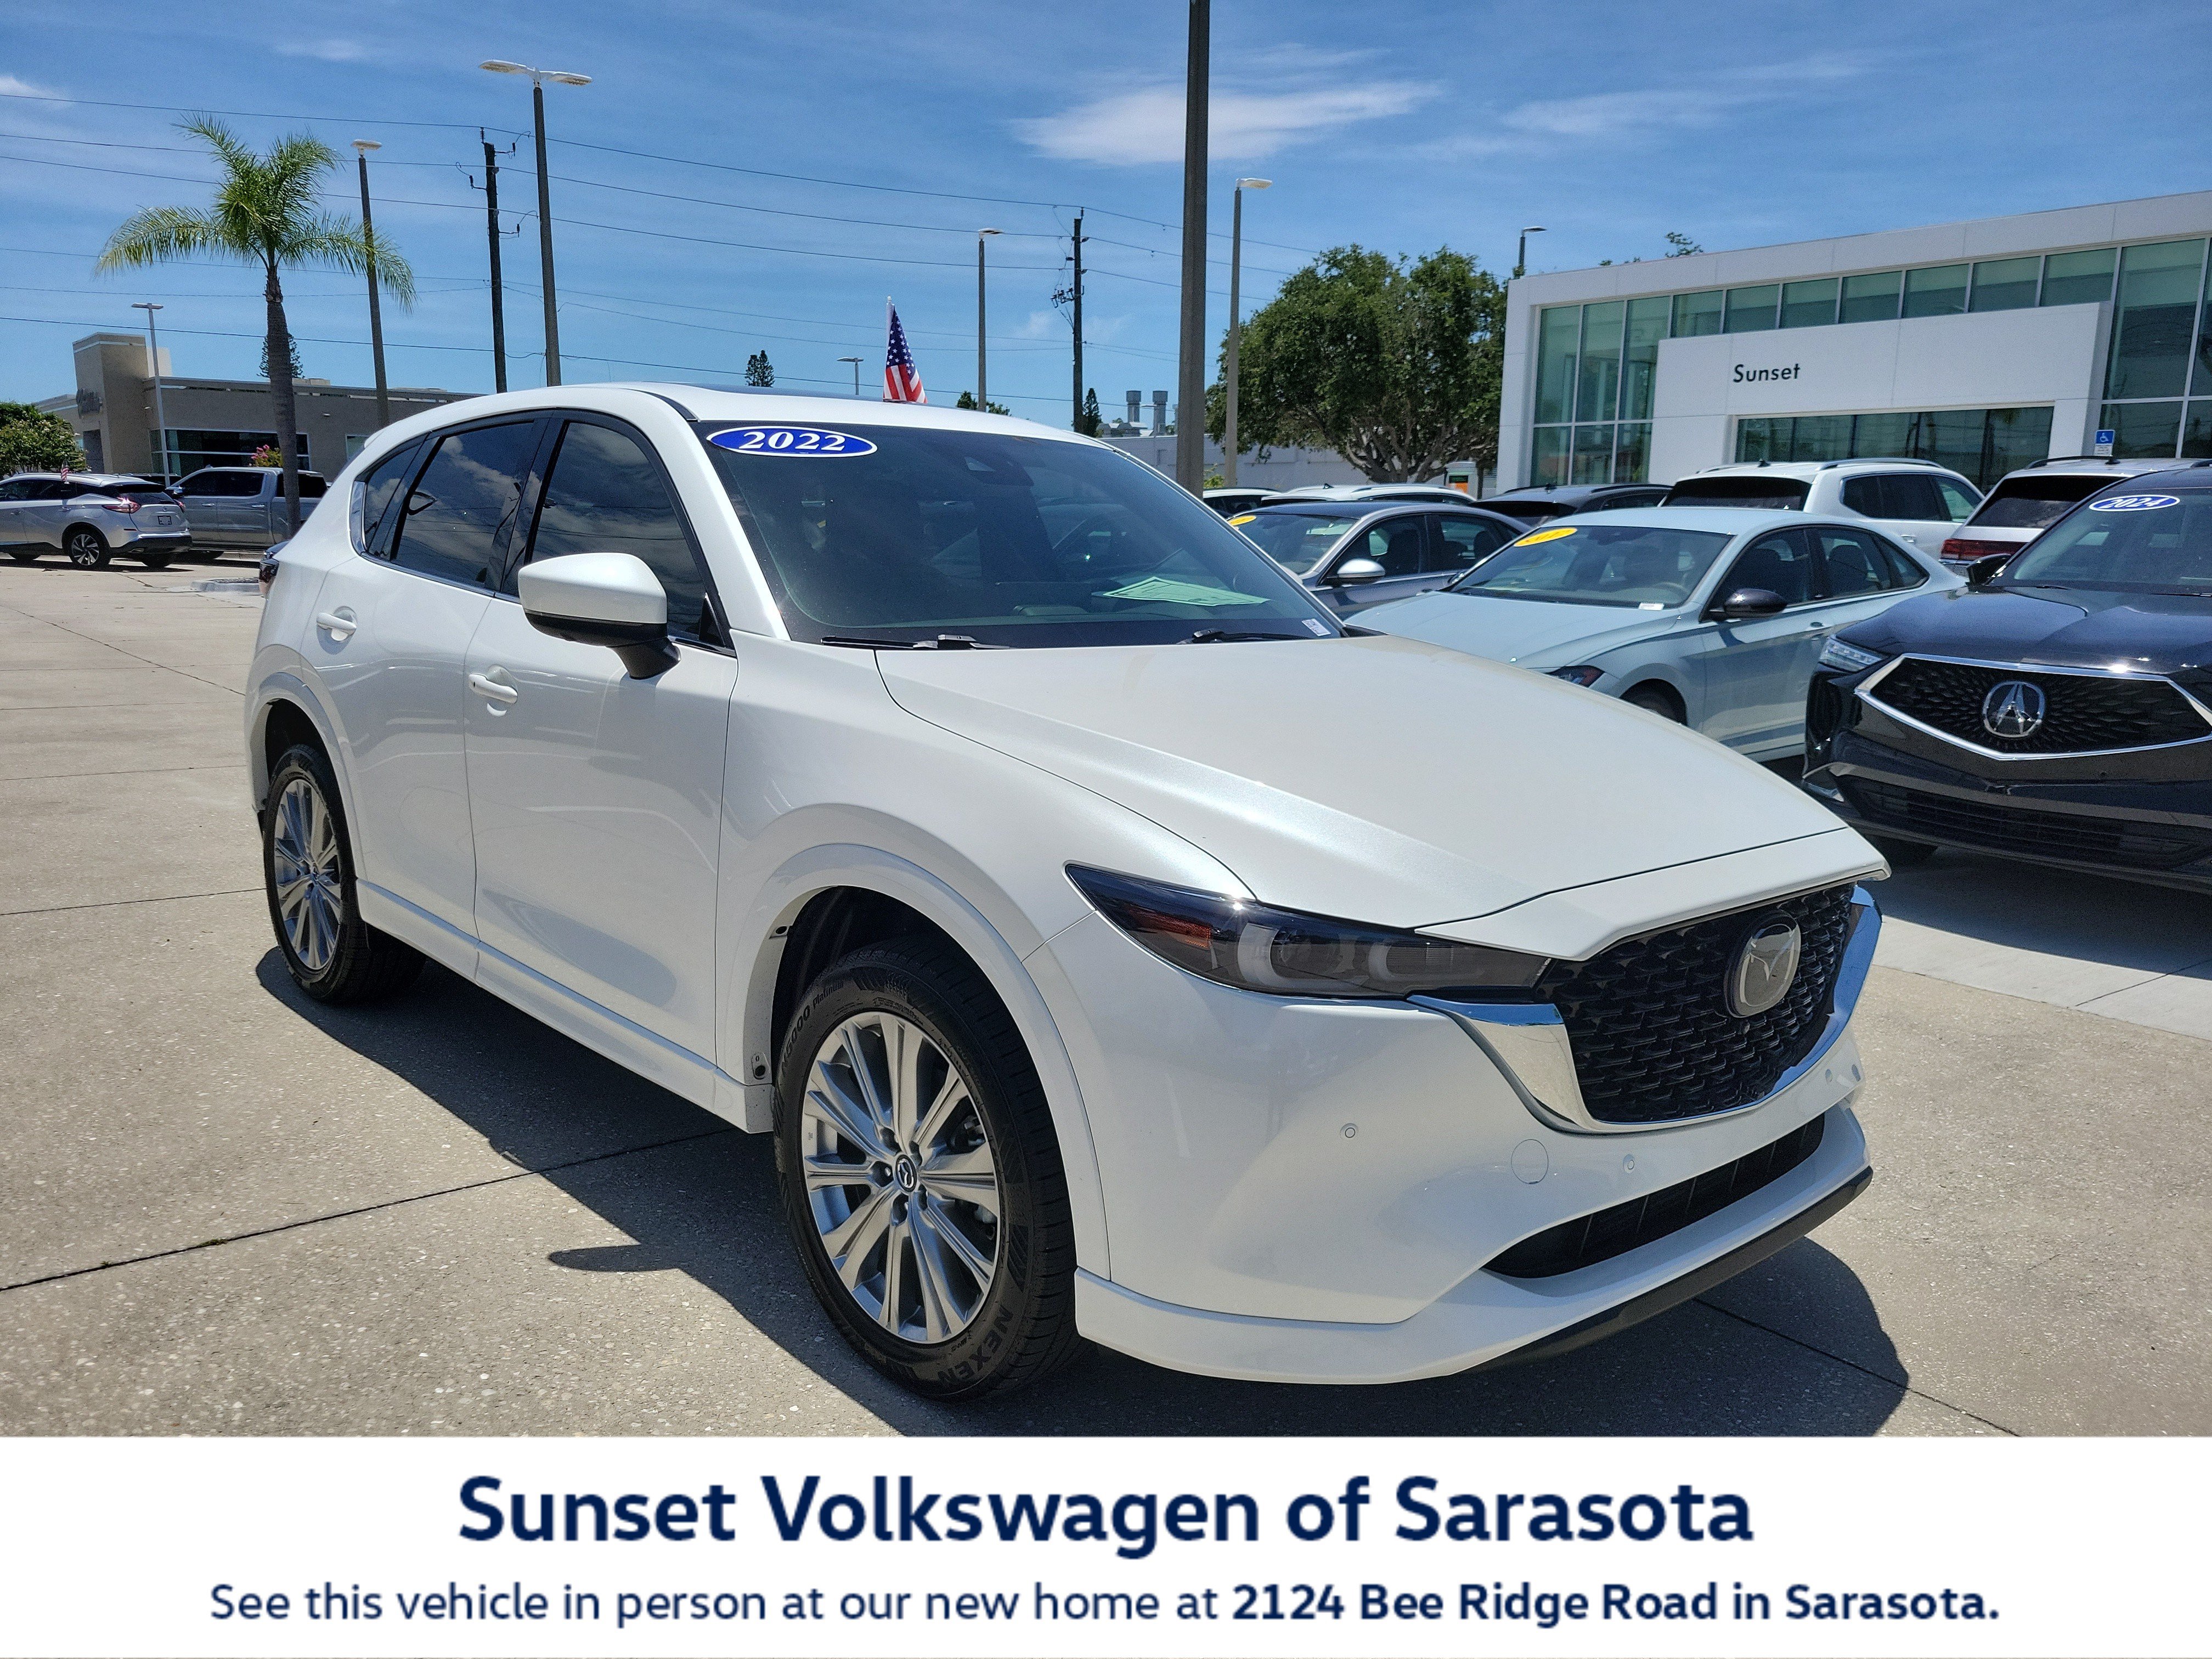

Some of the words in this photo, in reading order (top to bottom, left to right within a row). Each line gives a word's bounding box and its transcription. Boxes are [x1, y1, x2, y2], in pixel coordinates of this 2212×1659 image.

[1733, 363, 1801, 383] Sunset
[738, 431, 846, 452] 2022
[2100, 498, 2169, 509] 2024
[937, 1305, 1014, 1383] NEXEN
